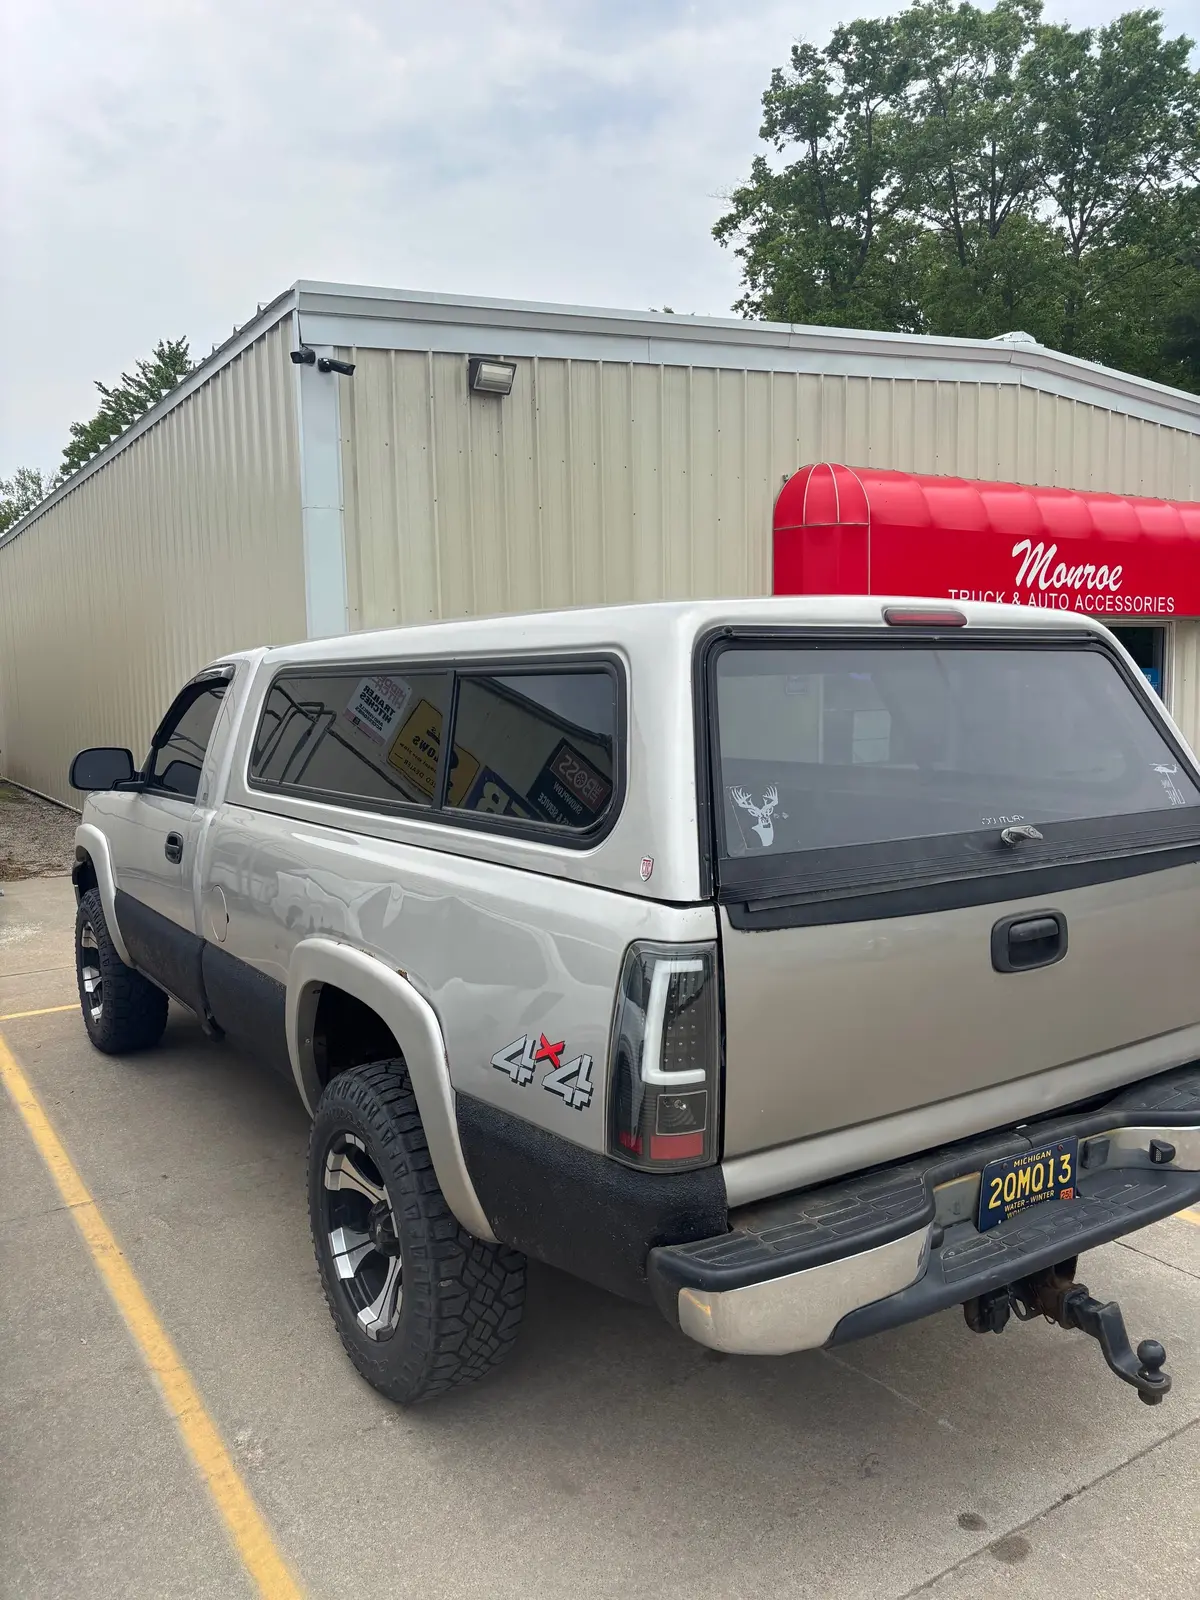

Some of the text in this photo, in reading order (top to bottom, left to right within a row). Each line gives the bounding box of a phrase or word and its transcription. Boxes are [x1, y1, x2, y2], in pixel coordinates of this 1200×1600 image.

[1011, 538, 1123, 592] Monroe
[948, 588, 1006, 604] TRUCK
[1029, 593, 1069, 611] AUTO
[1075, 594, 1175, 613] ACCESSORIES
[1013, 1150, 1052, 1168] MICHIGAN
